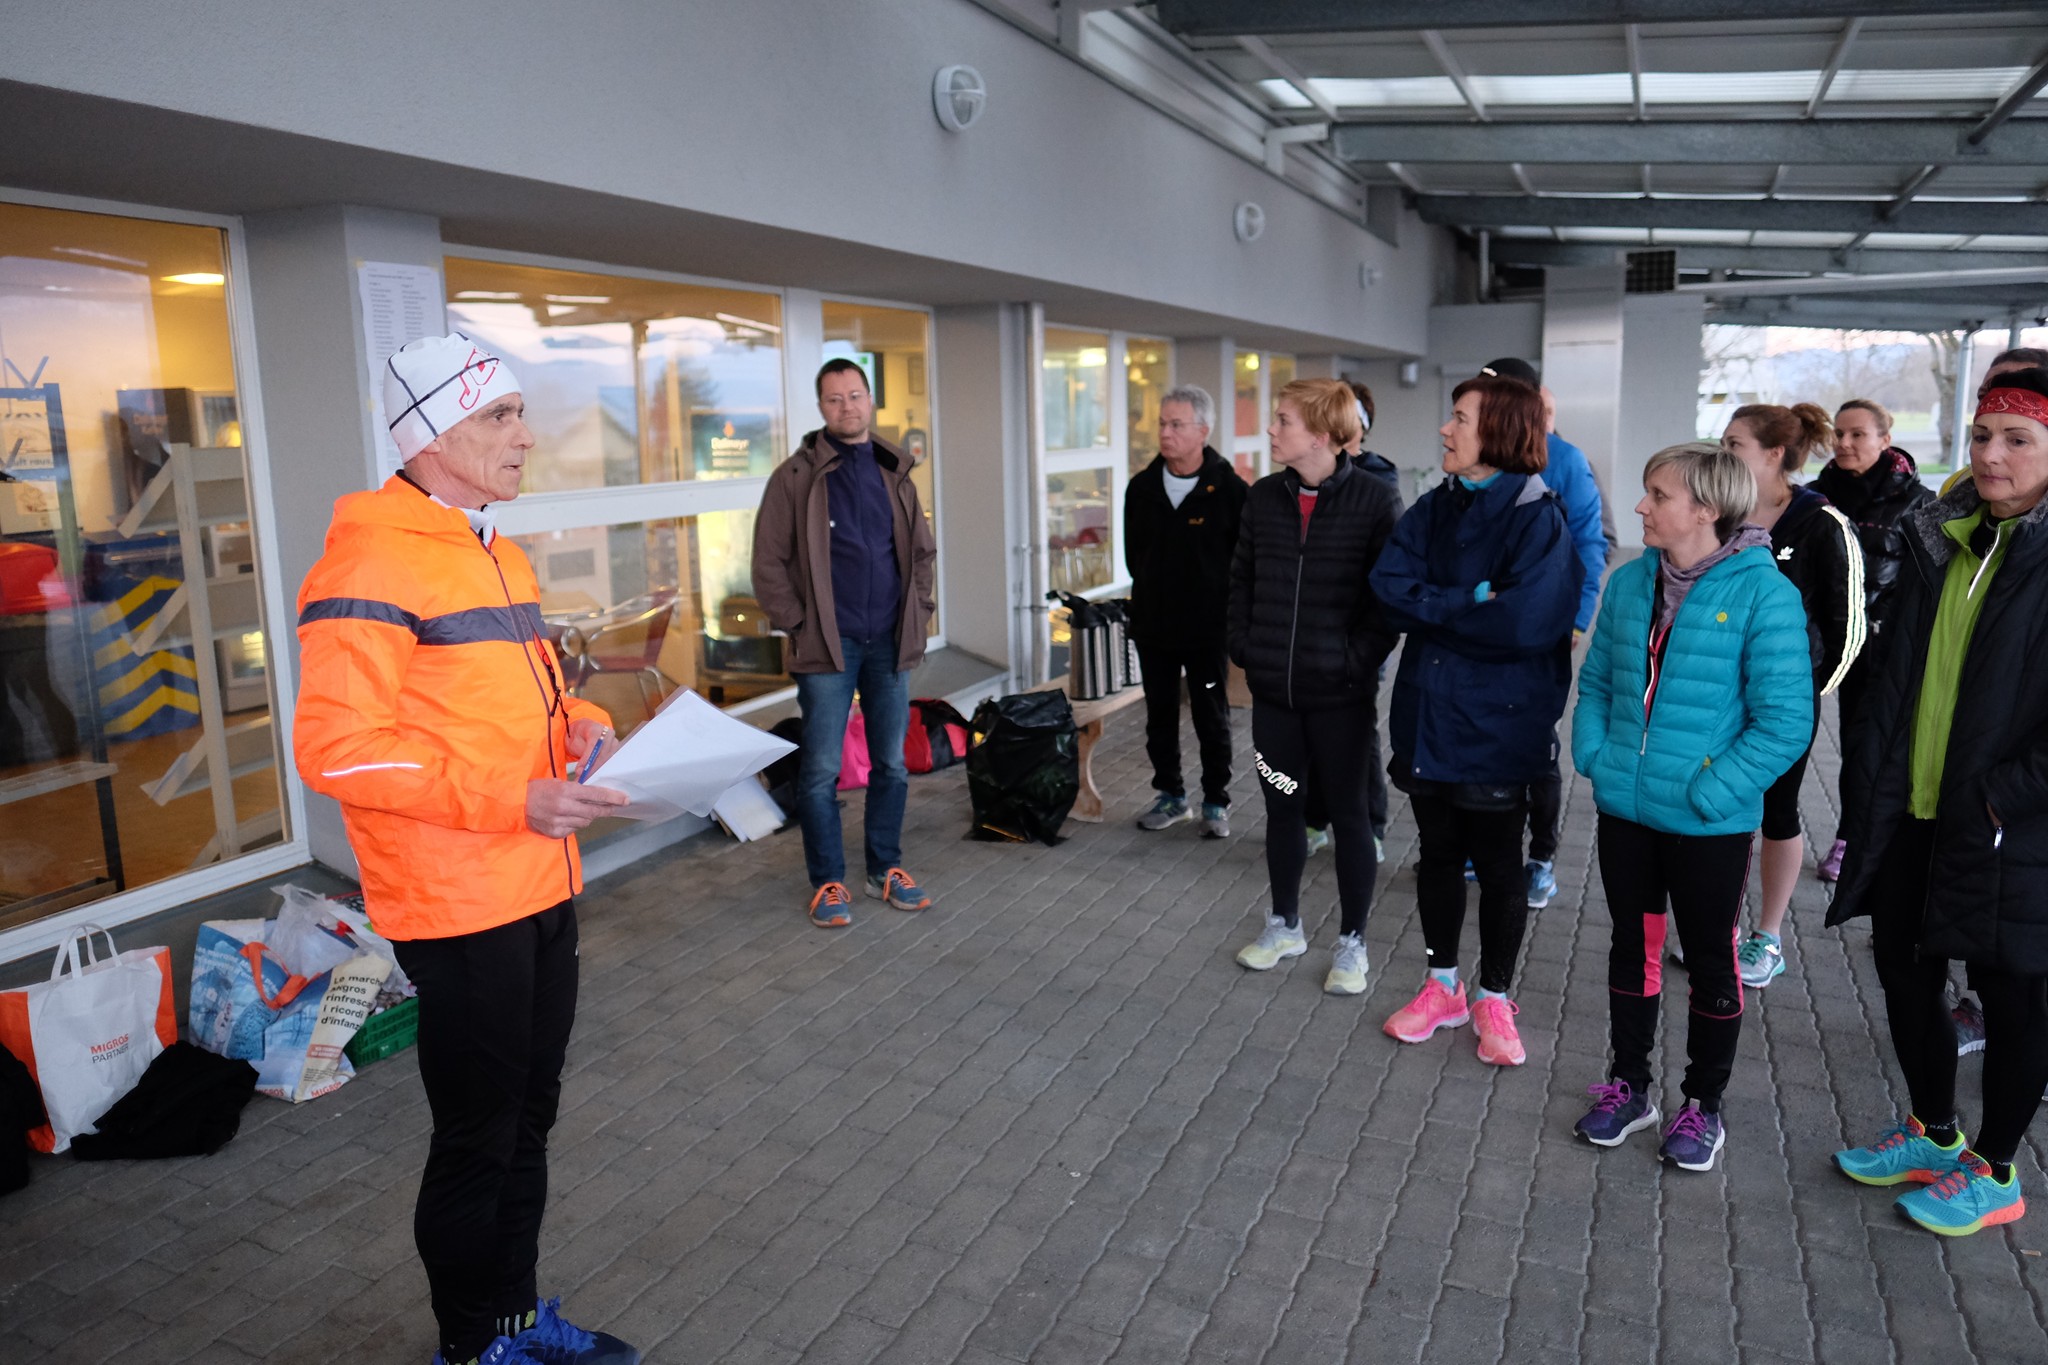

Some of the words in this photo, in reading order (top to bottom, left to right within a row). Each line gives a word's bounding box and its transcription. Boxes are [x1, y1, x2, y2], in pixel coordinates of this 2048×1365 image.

[334, 976, 345, 984] Le
[330, 1006, 364, 1019] ricordi
[90, 1033, 129, 1054] MIGROS
[92, 1043, 129, 1063] PARTNER
